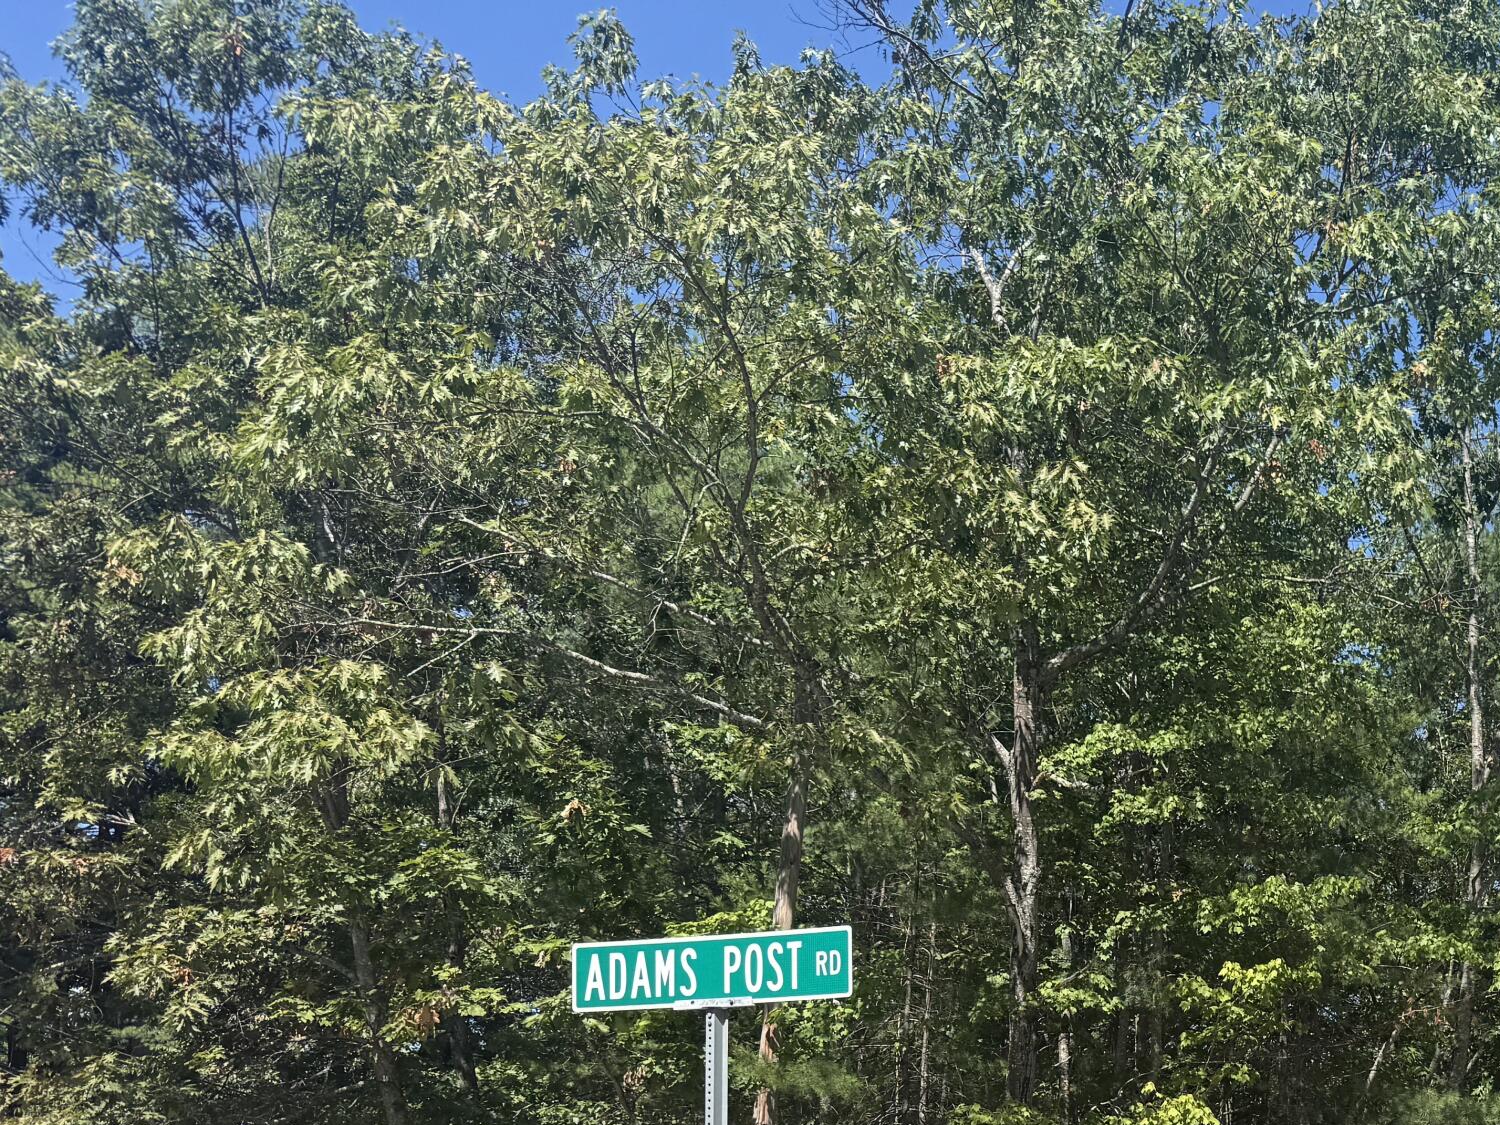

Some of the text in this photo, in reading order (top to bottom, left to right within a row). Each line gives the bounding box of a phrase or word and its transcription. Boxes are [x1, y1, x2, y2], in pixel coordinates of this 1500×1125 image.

[584, 940, 841, 1001] ADAMS POST RD
